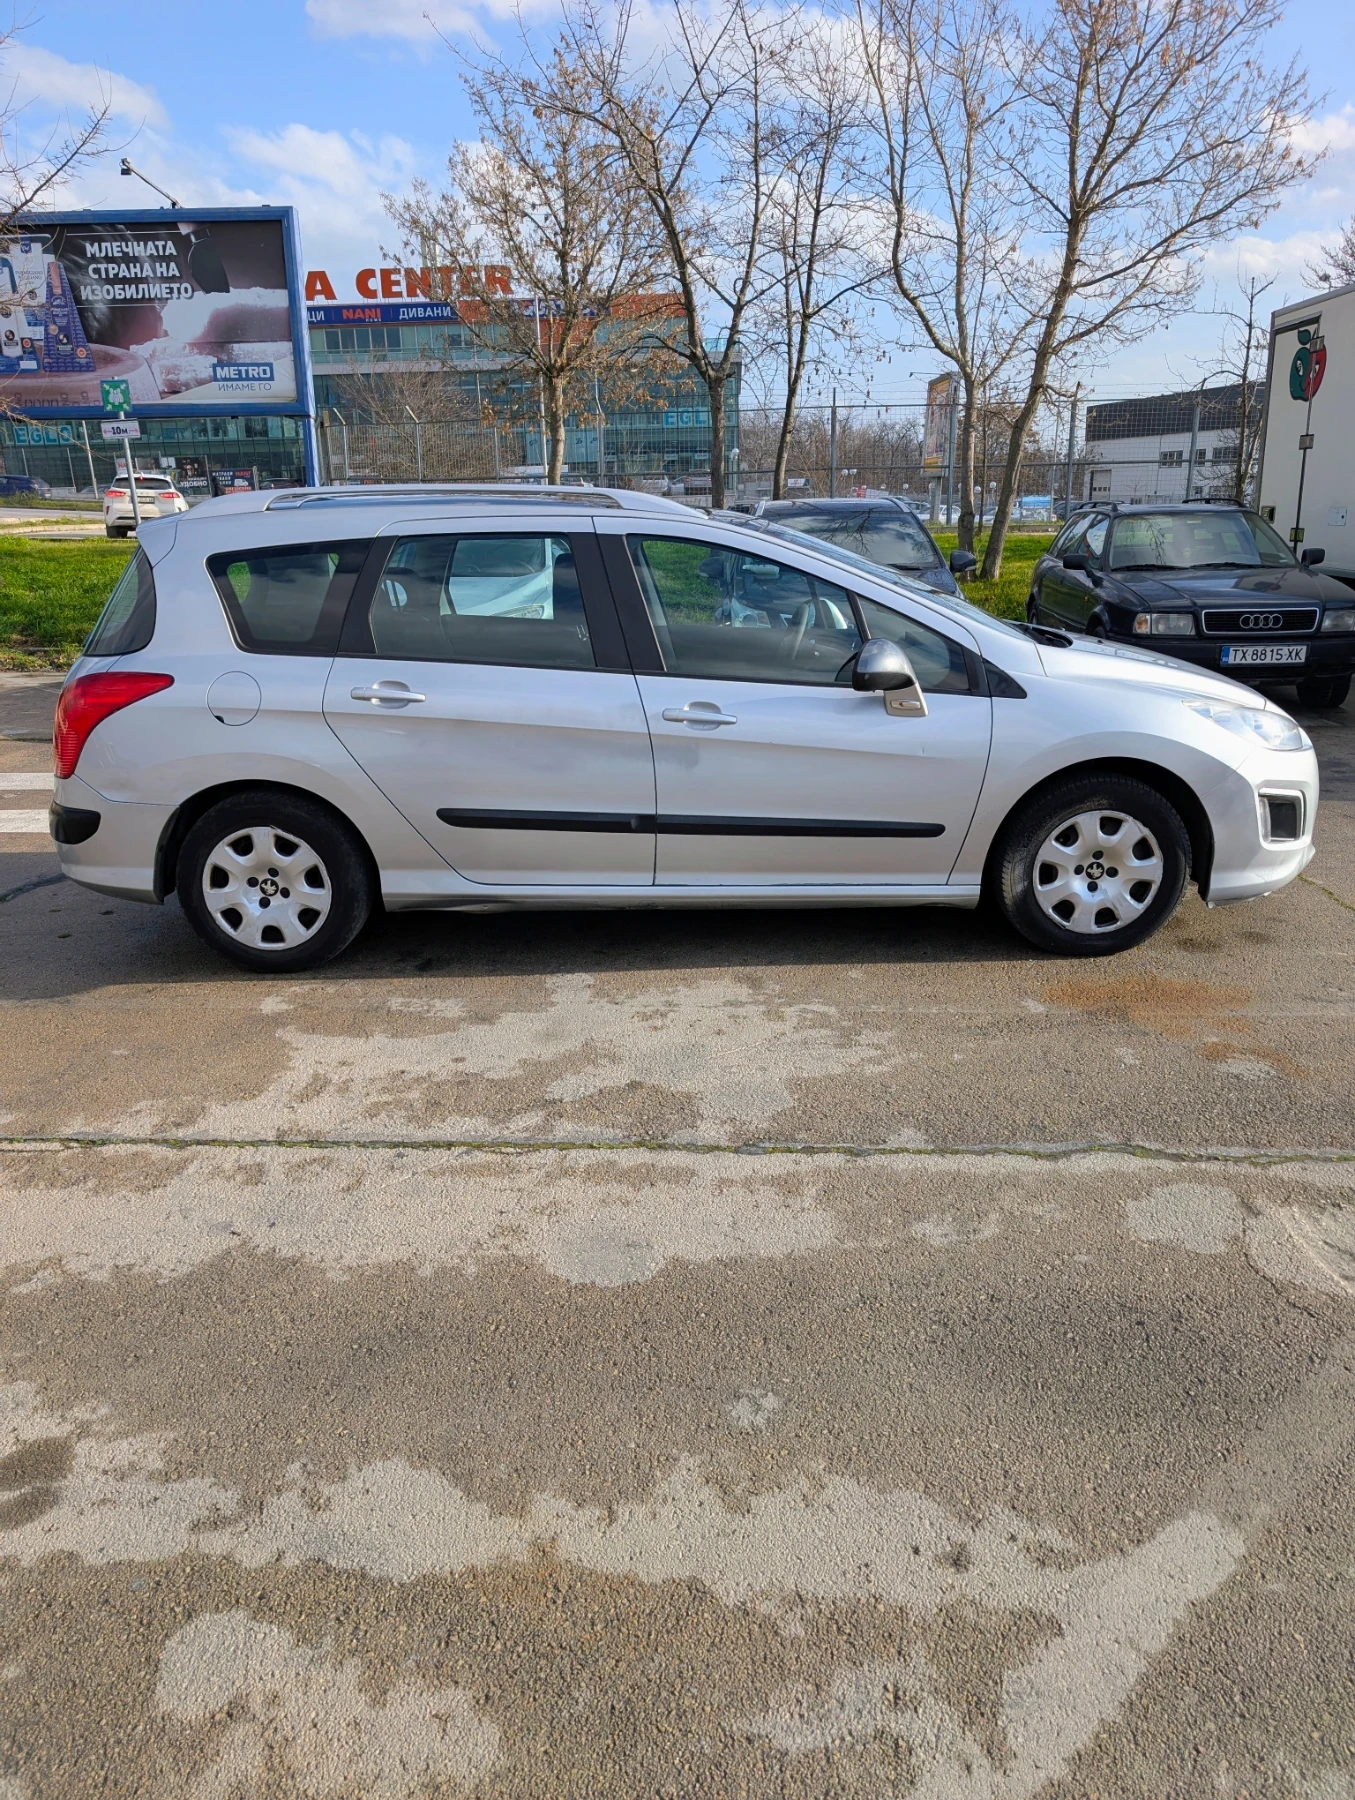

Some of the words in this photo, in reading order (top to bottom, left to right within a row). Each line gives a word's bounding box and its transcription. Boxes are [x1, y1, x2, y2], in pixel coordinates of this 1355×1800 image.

[85, 241, 177, 258] МЛЕЧНАТА
[88, 263, 153, 279] СТРАНА
[156, 262, 180, 277] НА
[355, 265, 514, 300] CENTER
[80, 283, 193, 300] ИЗОБИЛИЕТО
[342, 308, 381, 320] NANI
[399, 306, 451, 319] ДИВАНИ
[216, 366, 271, 380] METRO
[218, 383, 256, 392] ИМАМЕ
[258, 382, 272, 392] ГО
[664, 406, 708, 426] EGL
[14, 427, 71, 444] EGLO
